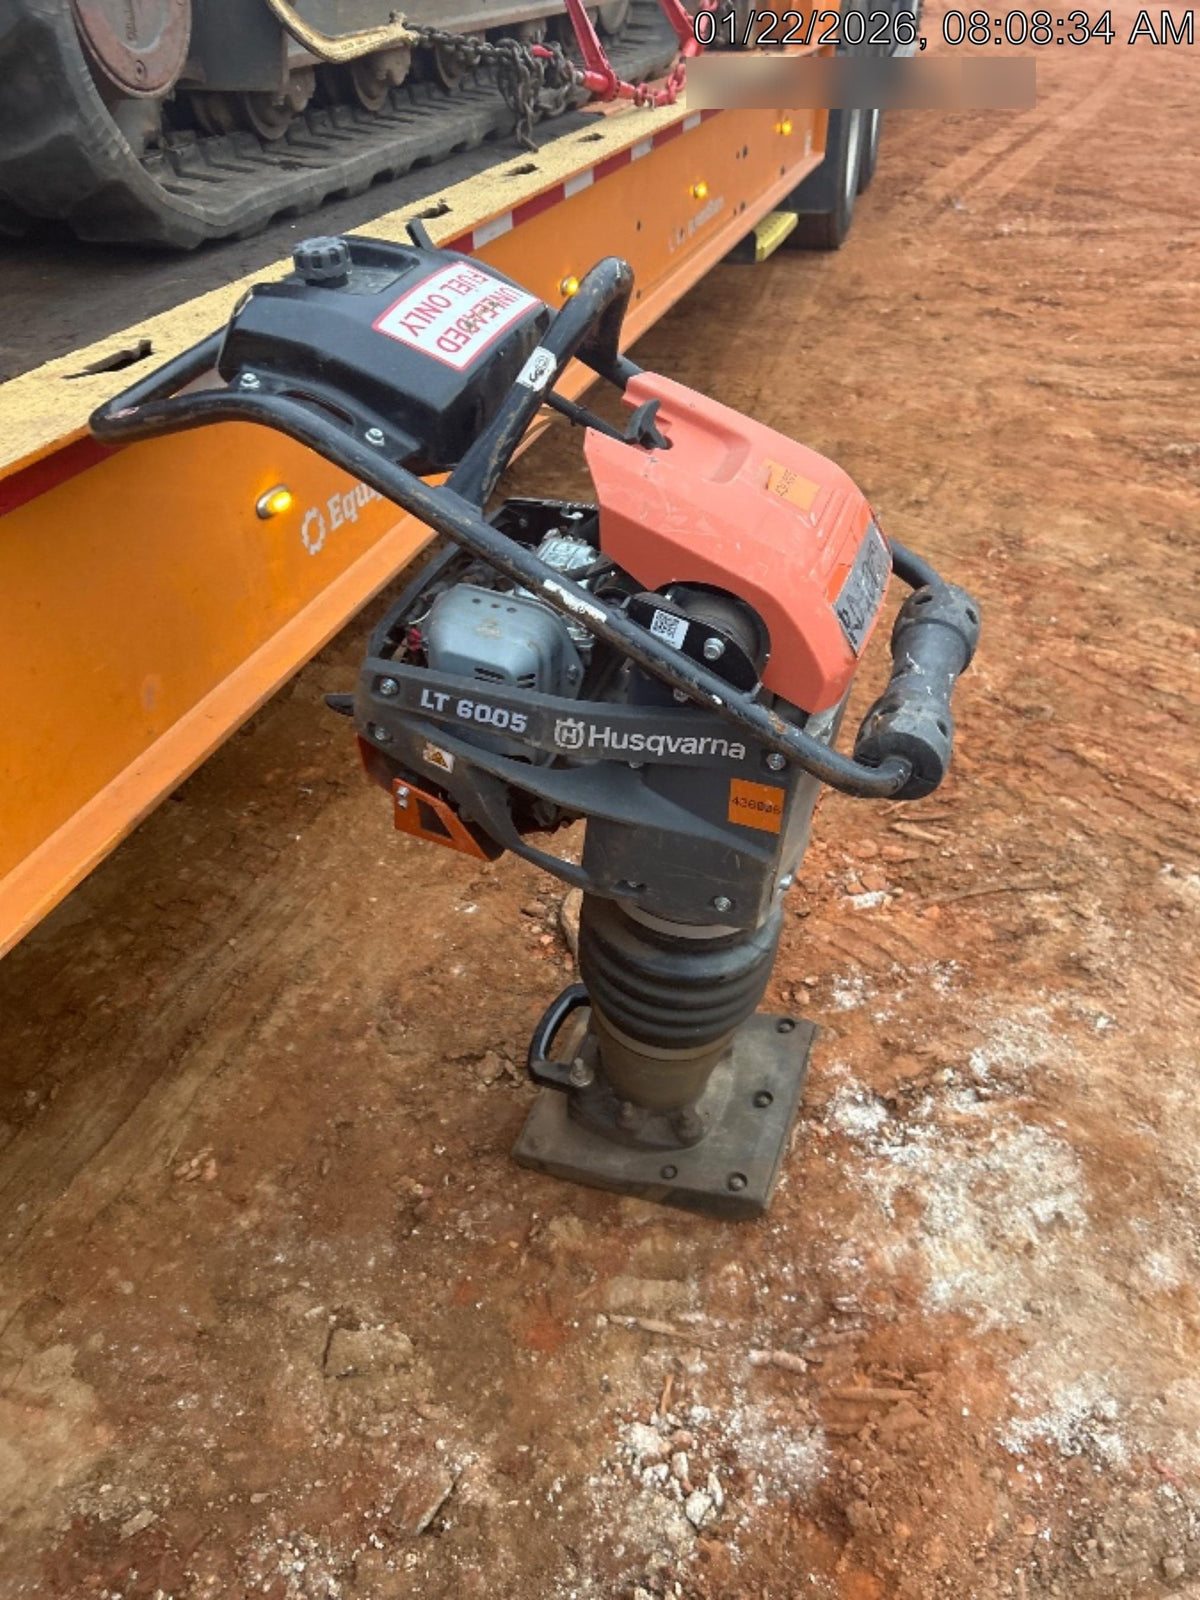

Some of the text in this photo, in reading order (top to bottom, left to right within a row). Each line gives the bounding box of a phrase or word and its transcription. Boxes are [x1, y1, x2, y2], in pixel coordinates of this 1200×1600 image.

[398, 269, 489, 338] FUEL ONLY
[436, 287, 524, 353] UNLEADED
[420, 688, 529, 734] LT 6005
[588, 724, 747, 761] Husqvarna
